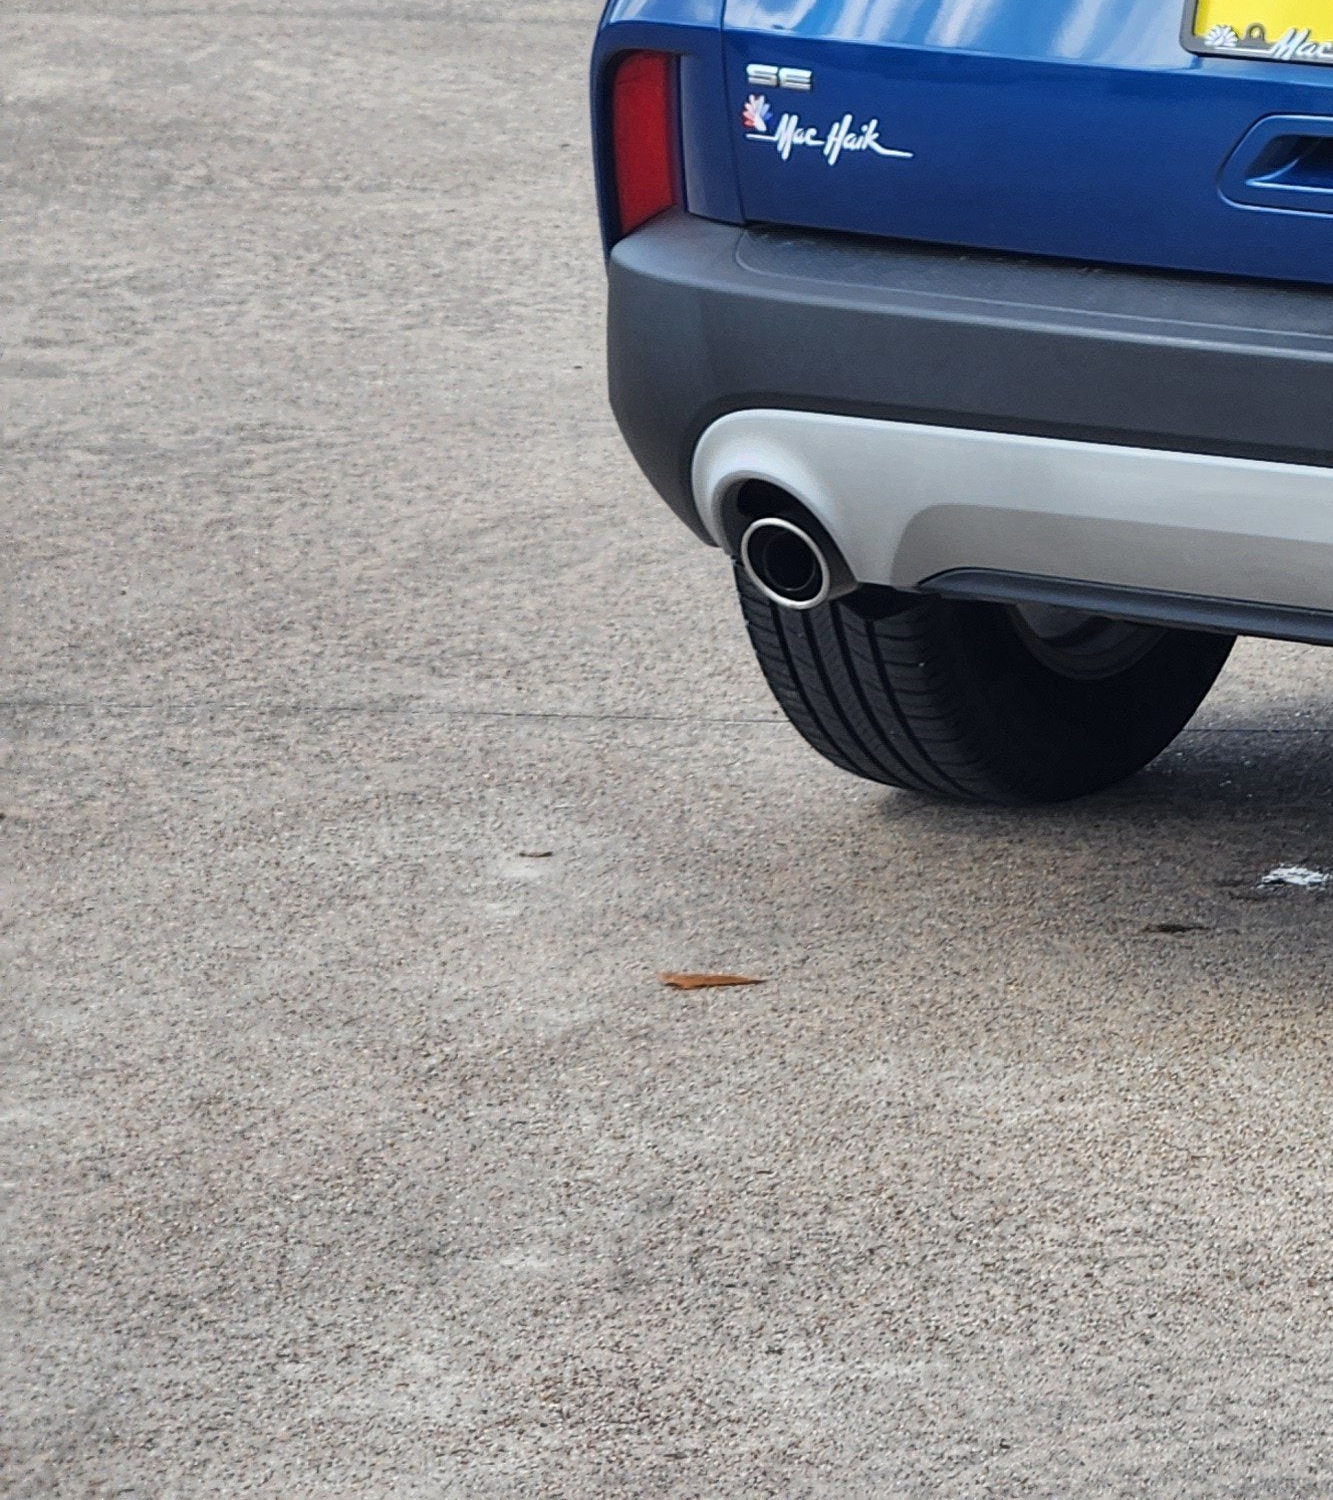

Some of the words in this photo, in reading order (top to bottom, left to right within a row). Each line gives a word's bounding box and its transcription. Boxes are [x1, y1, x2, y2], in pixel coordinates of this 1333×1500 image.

[746, 63, 812, 91] SE
[774, 113, 825, 162] Mac
[823, 113, 914, 167] Haik
